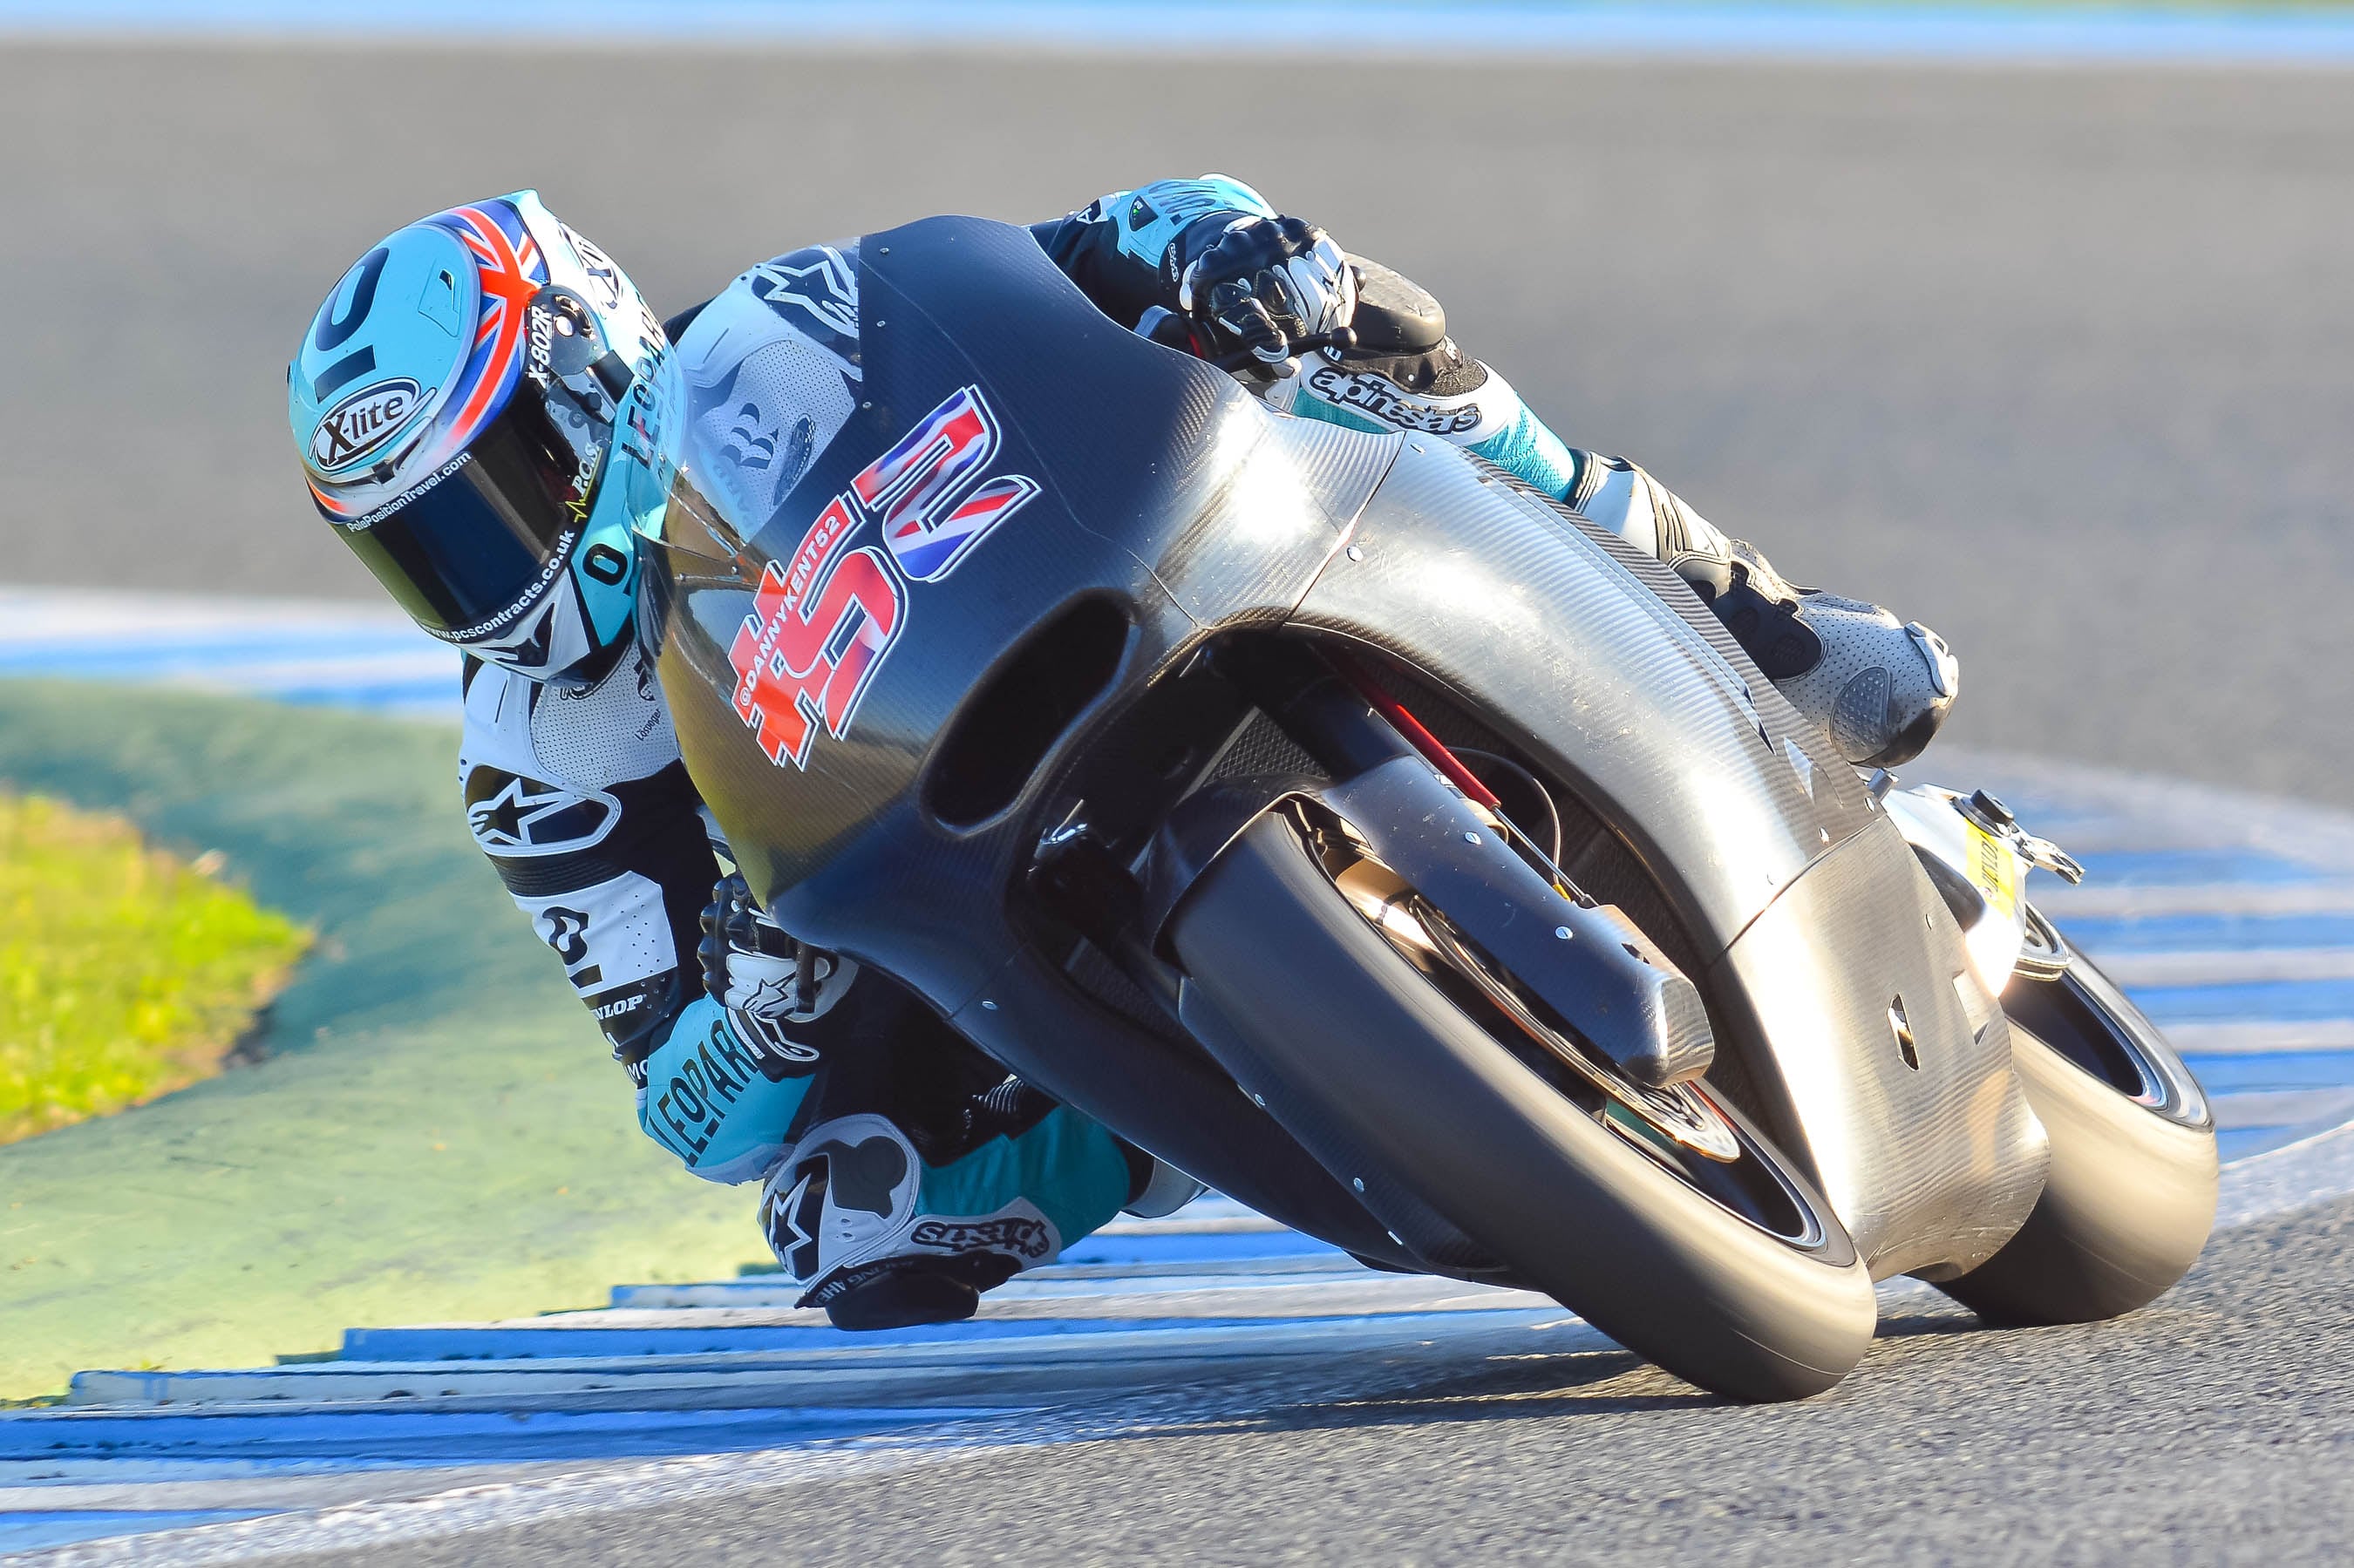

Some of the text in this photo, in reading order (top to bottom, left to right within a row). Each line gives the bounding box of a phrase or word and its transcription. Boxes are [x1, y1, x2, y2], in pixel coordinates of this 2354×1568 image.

[527, 305, 553, 390] X-802R
[621, 292, 667, 471] LEOPAR
[322, 396, 404, 465] X-lite
[1310, 366, 1484, 435] alpinestars
[346, 451, 472, 533] PolePositionTravel.com
[424, 530, 575, 641] ww.pcscontracts.co.uk
[740, 515, 840, 707] @DANNYKENT52
[593, 994, 644, 1021] NLOP
[649, 1019, 759, 1167] LEOPAR
